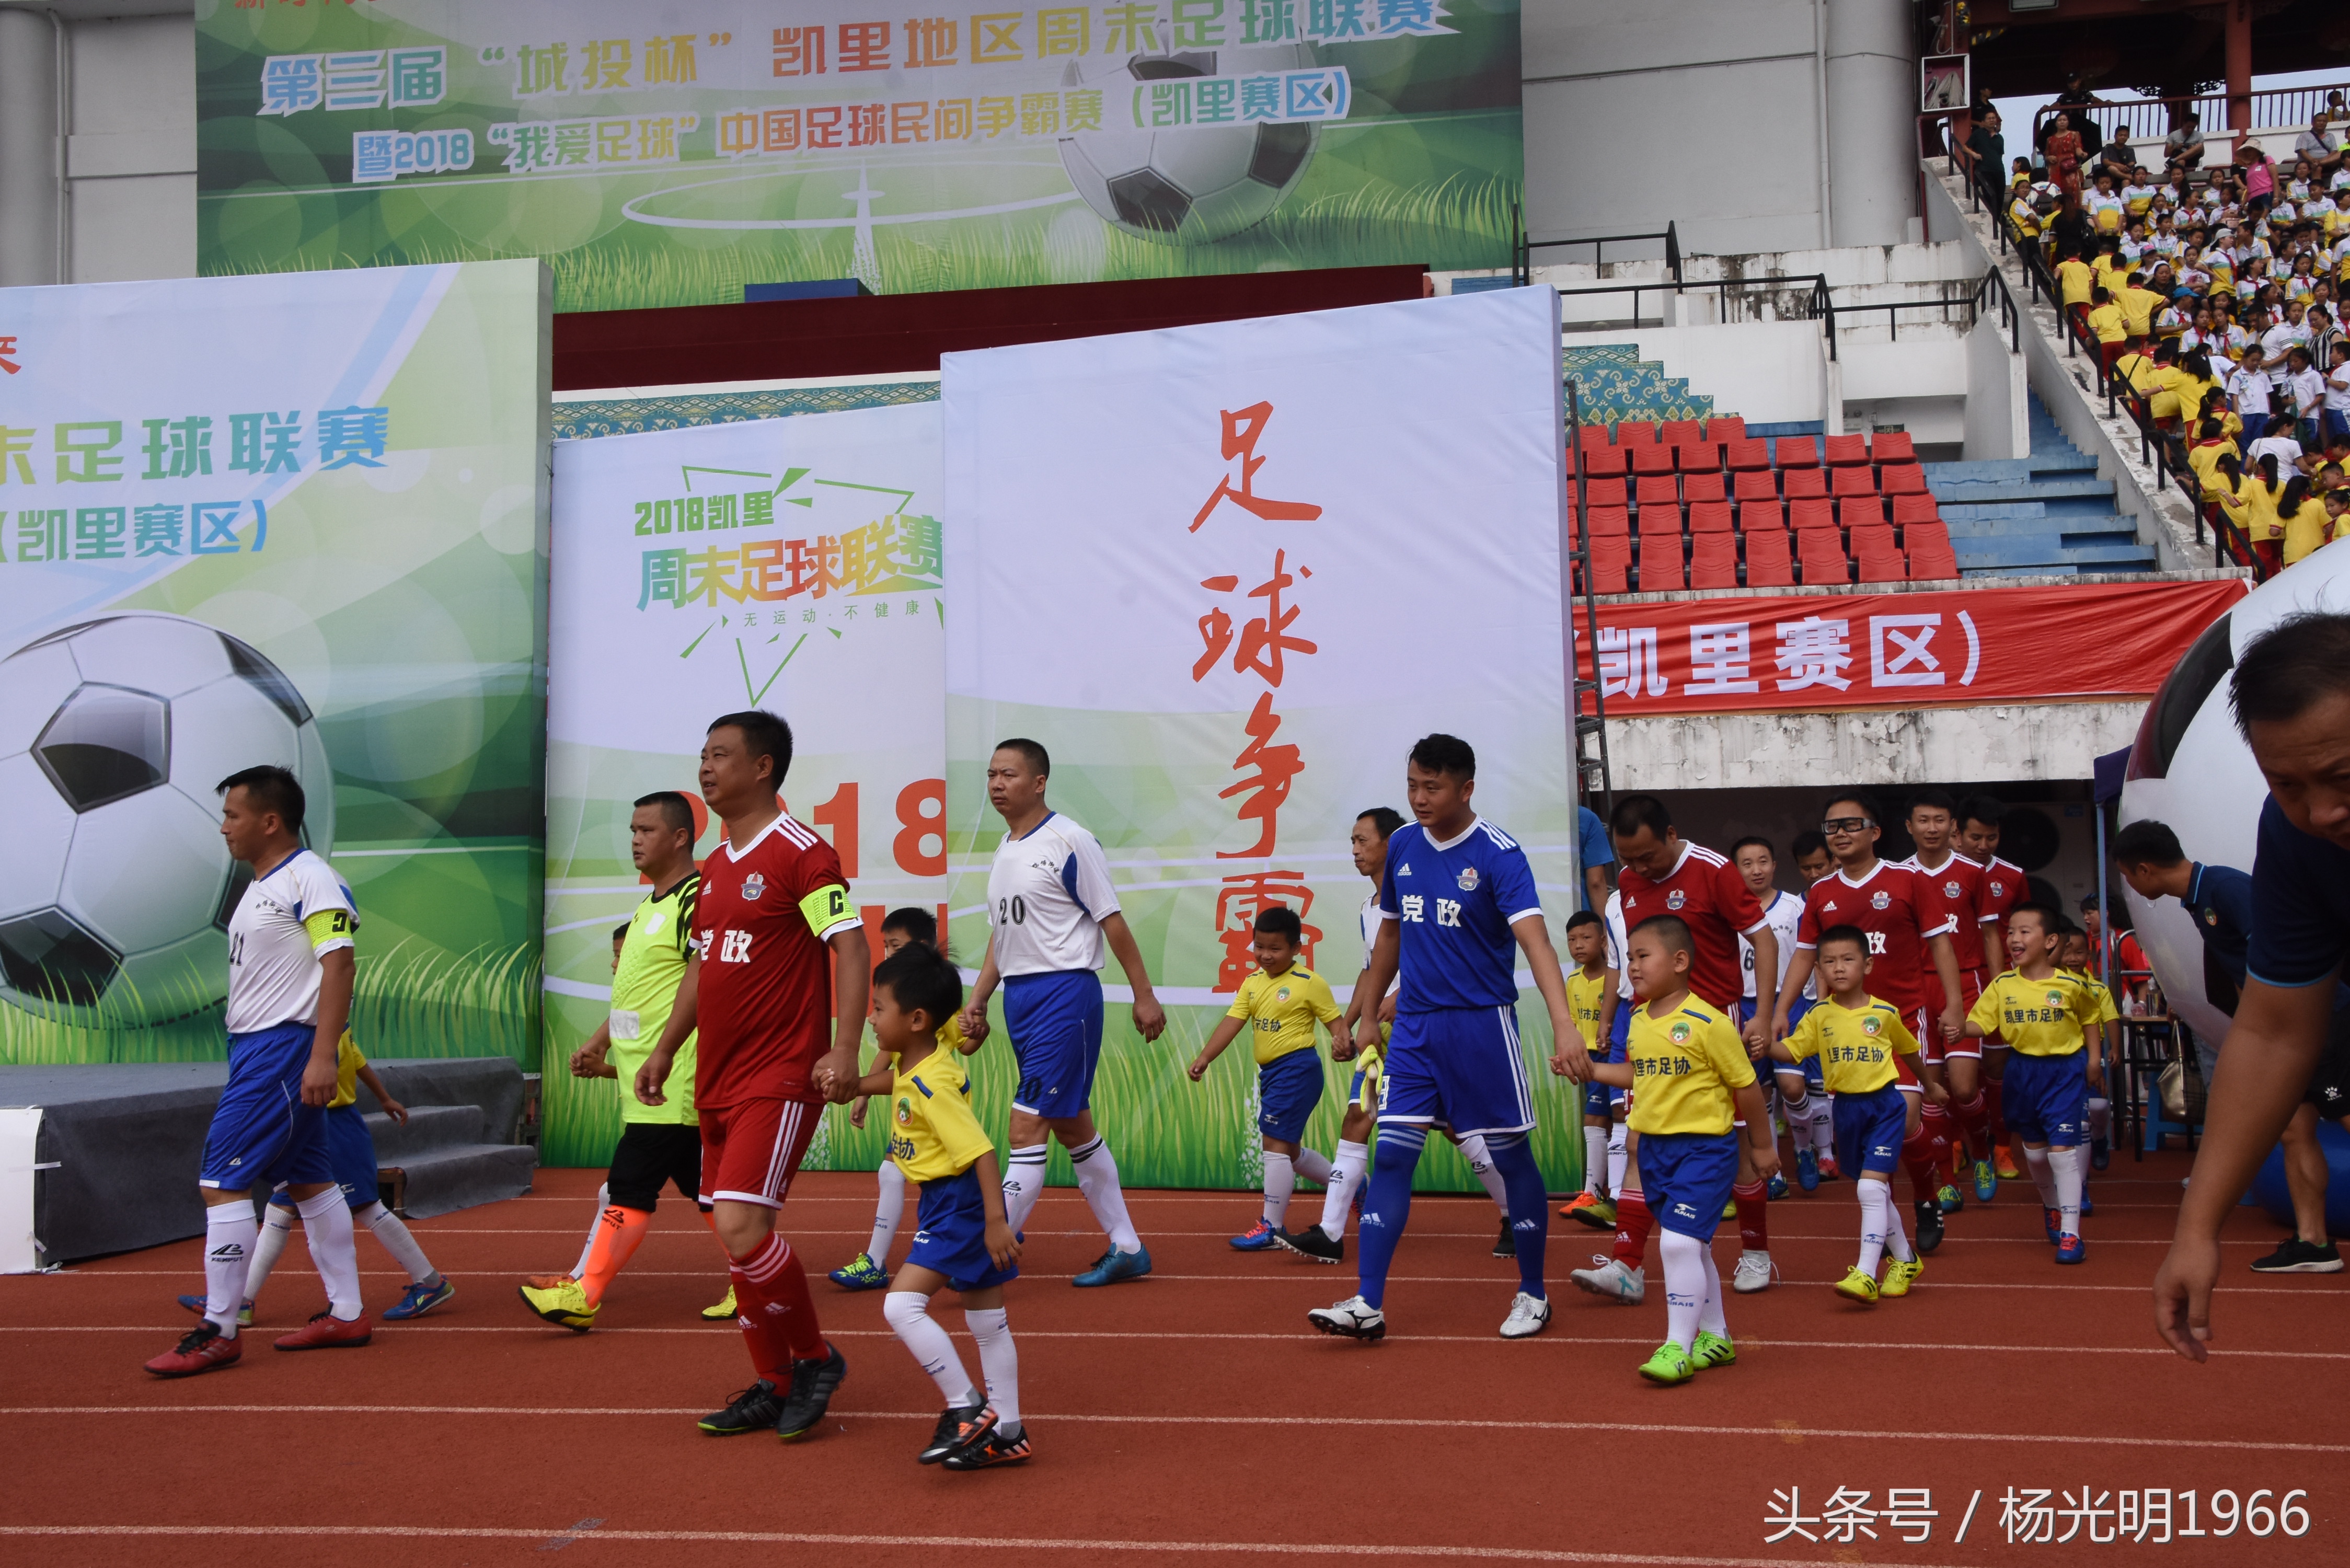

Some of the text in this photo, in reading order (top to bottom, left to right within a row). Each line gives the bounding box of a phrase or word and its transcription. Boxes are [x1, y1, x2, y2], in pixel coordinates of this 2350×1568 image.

[265, 48, 443, 109] 第三届
[773, 0, 1434, 77] 凯里地区周末足球联赛
[356, 131, 470, 177] 暨2018
[721, 89, 1103, 152] 中国足球民间争霸赛
[635, 490, 774, 536] 2018凯里
[636, 514, 943, 612] 周末足球联赛
[1574, 609, 1980, 701] 凯里赛区）
[1188, 400, 1323, 994] 足球争霸
[829, 890, 844, 917] C
[999, 894, 1026, 925] 20
[1401, 895, 1461, 927] 党政
[1743, 948, 1755, 971] 6
[2004, 1008, 2064, 1024] 凯里市足协
[1674, 1208, 1696, 1219] SUNAIS
